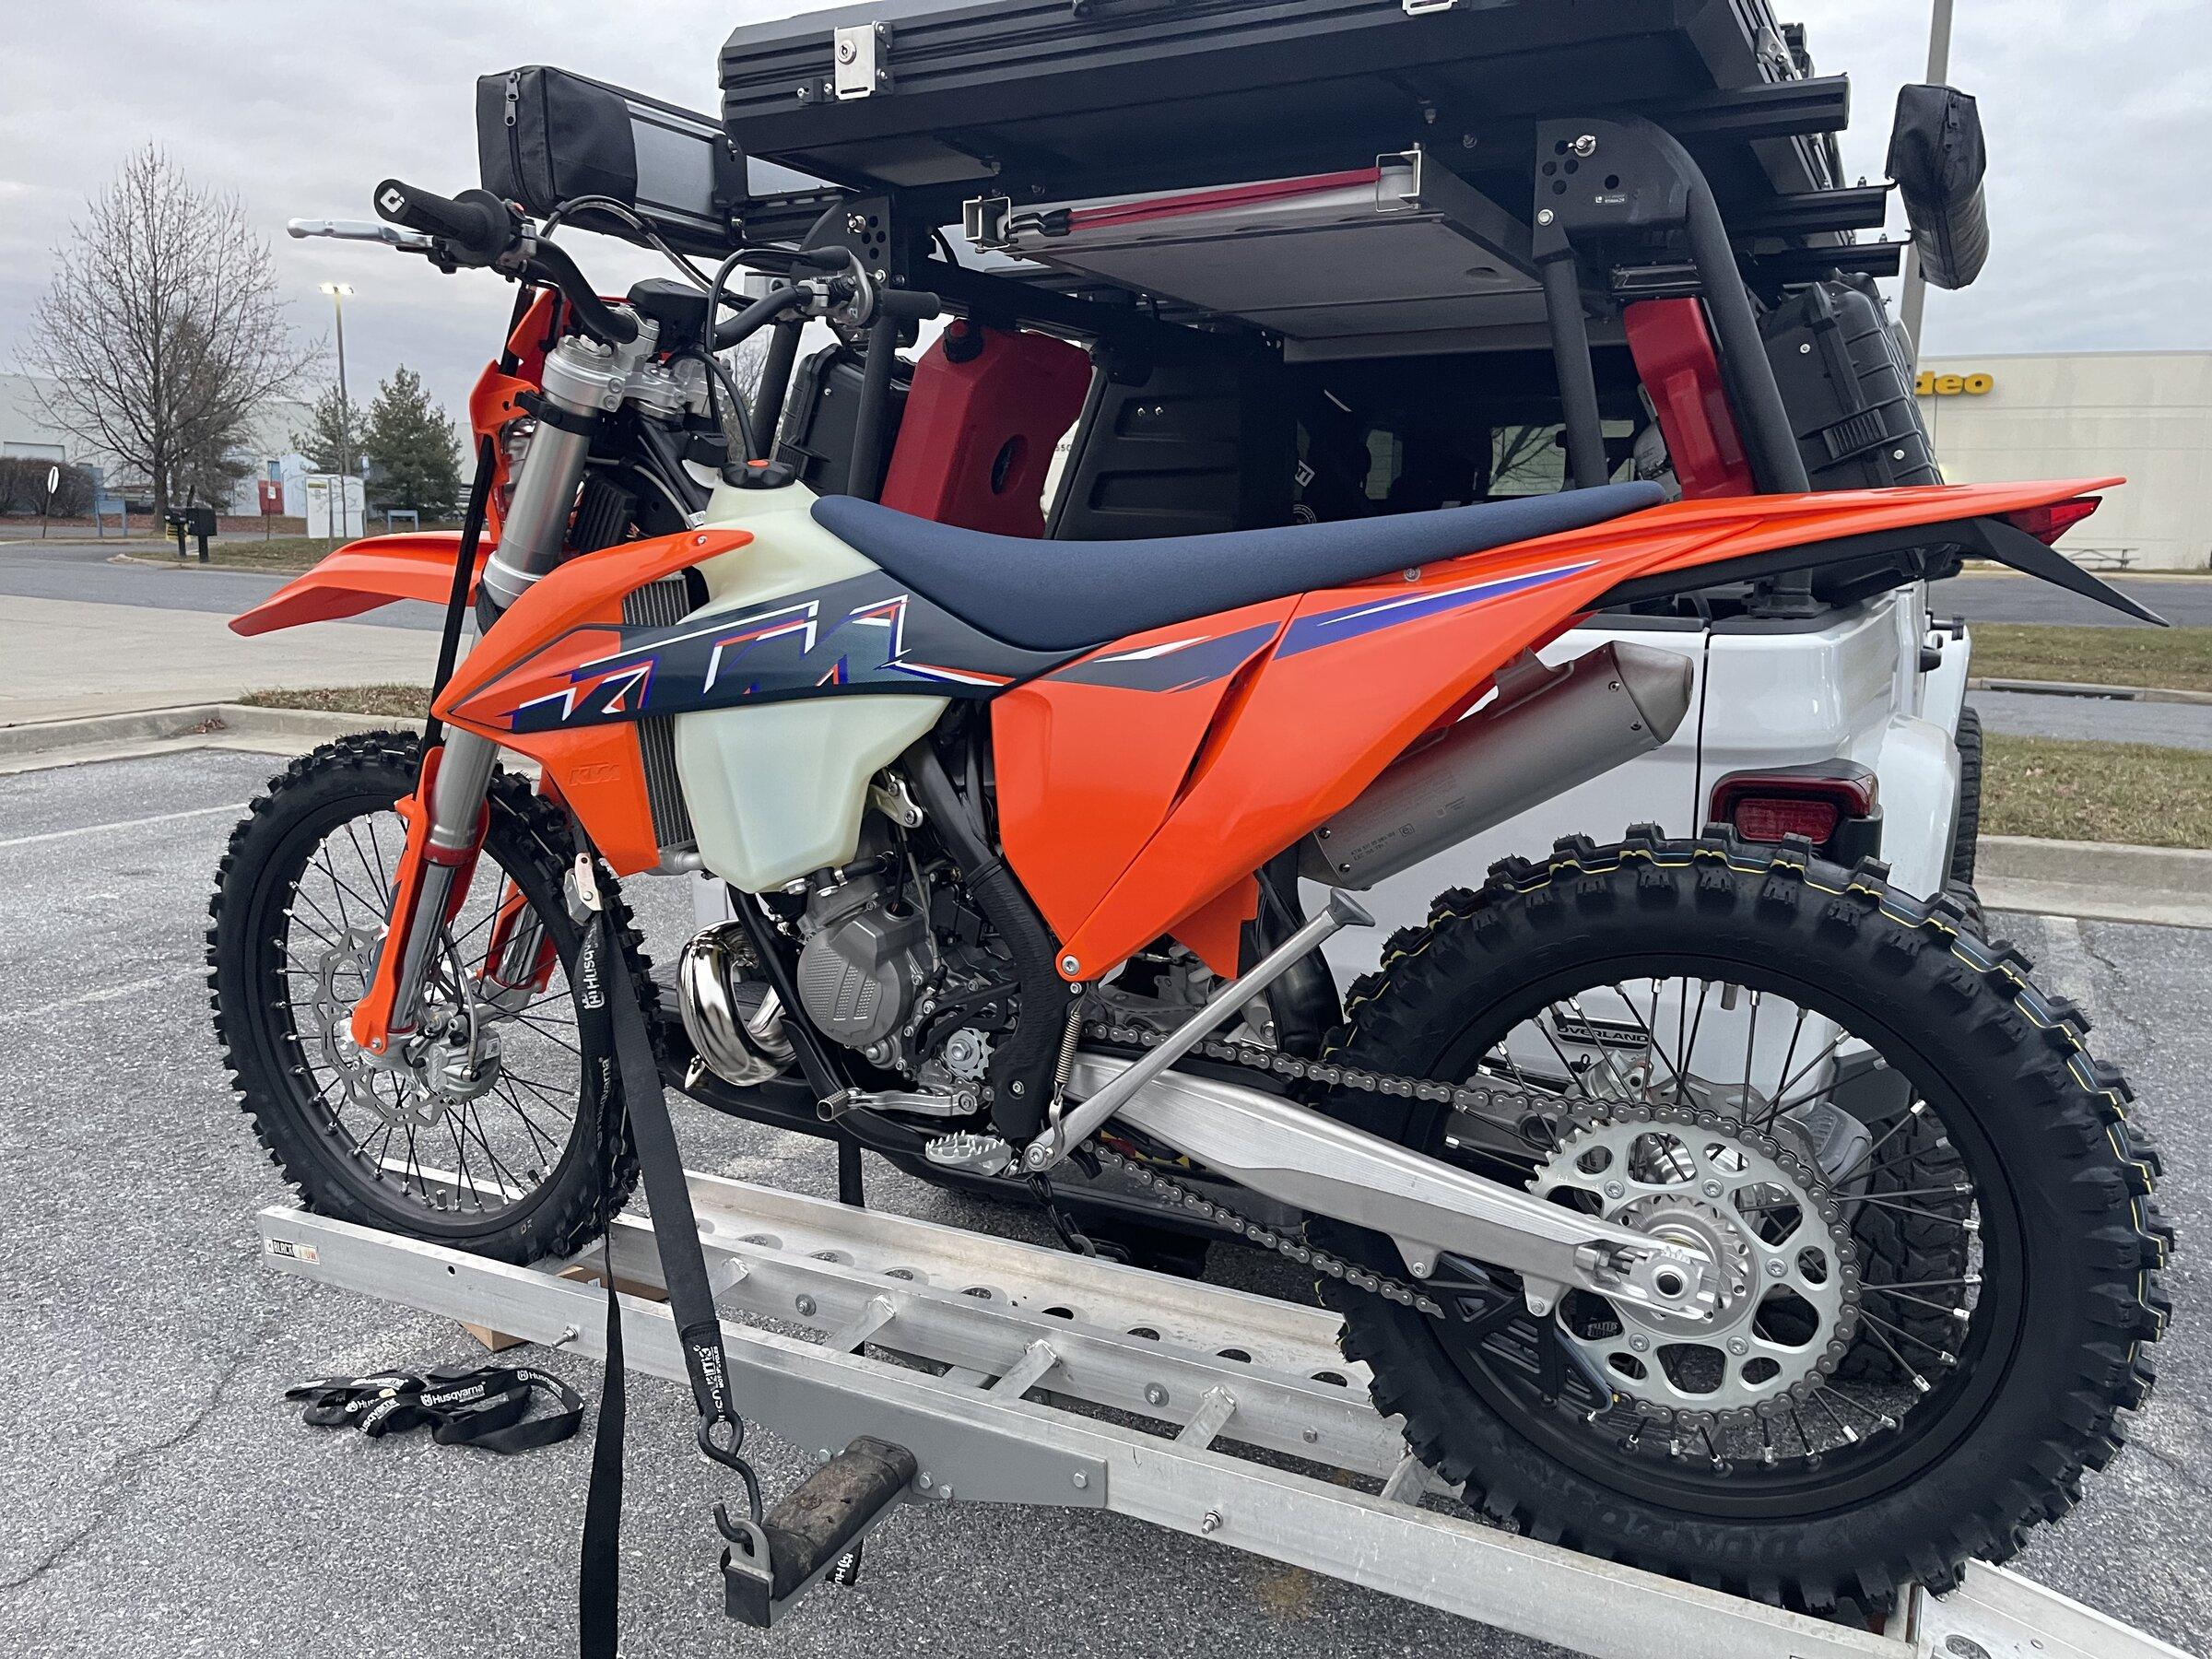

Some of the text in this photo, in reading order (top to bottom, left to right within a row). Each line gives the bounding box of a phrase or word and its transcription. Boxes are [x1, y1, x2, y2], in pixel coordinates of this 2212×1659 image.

[570, 762, 620, 786] KTM
[1558, 1026, 1649, 1041] OVERLAND
[432, 1383, 485, 1405] Husqvarna
